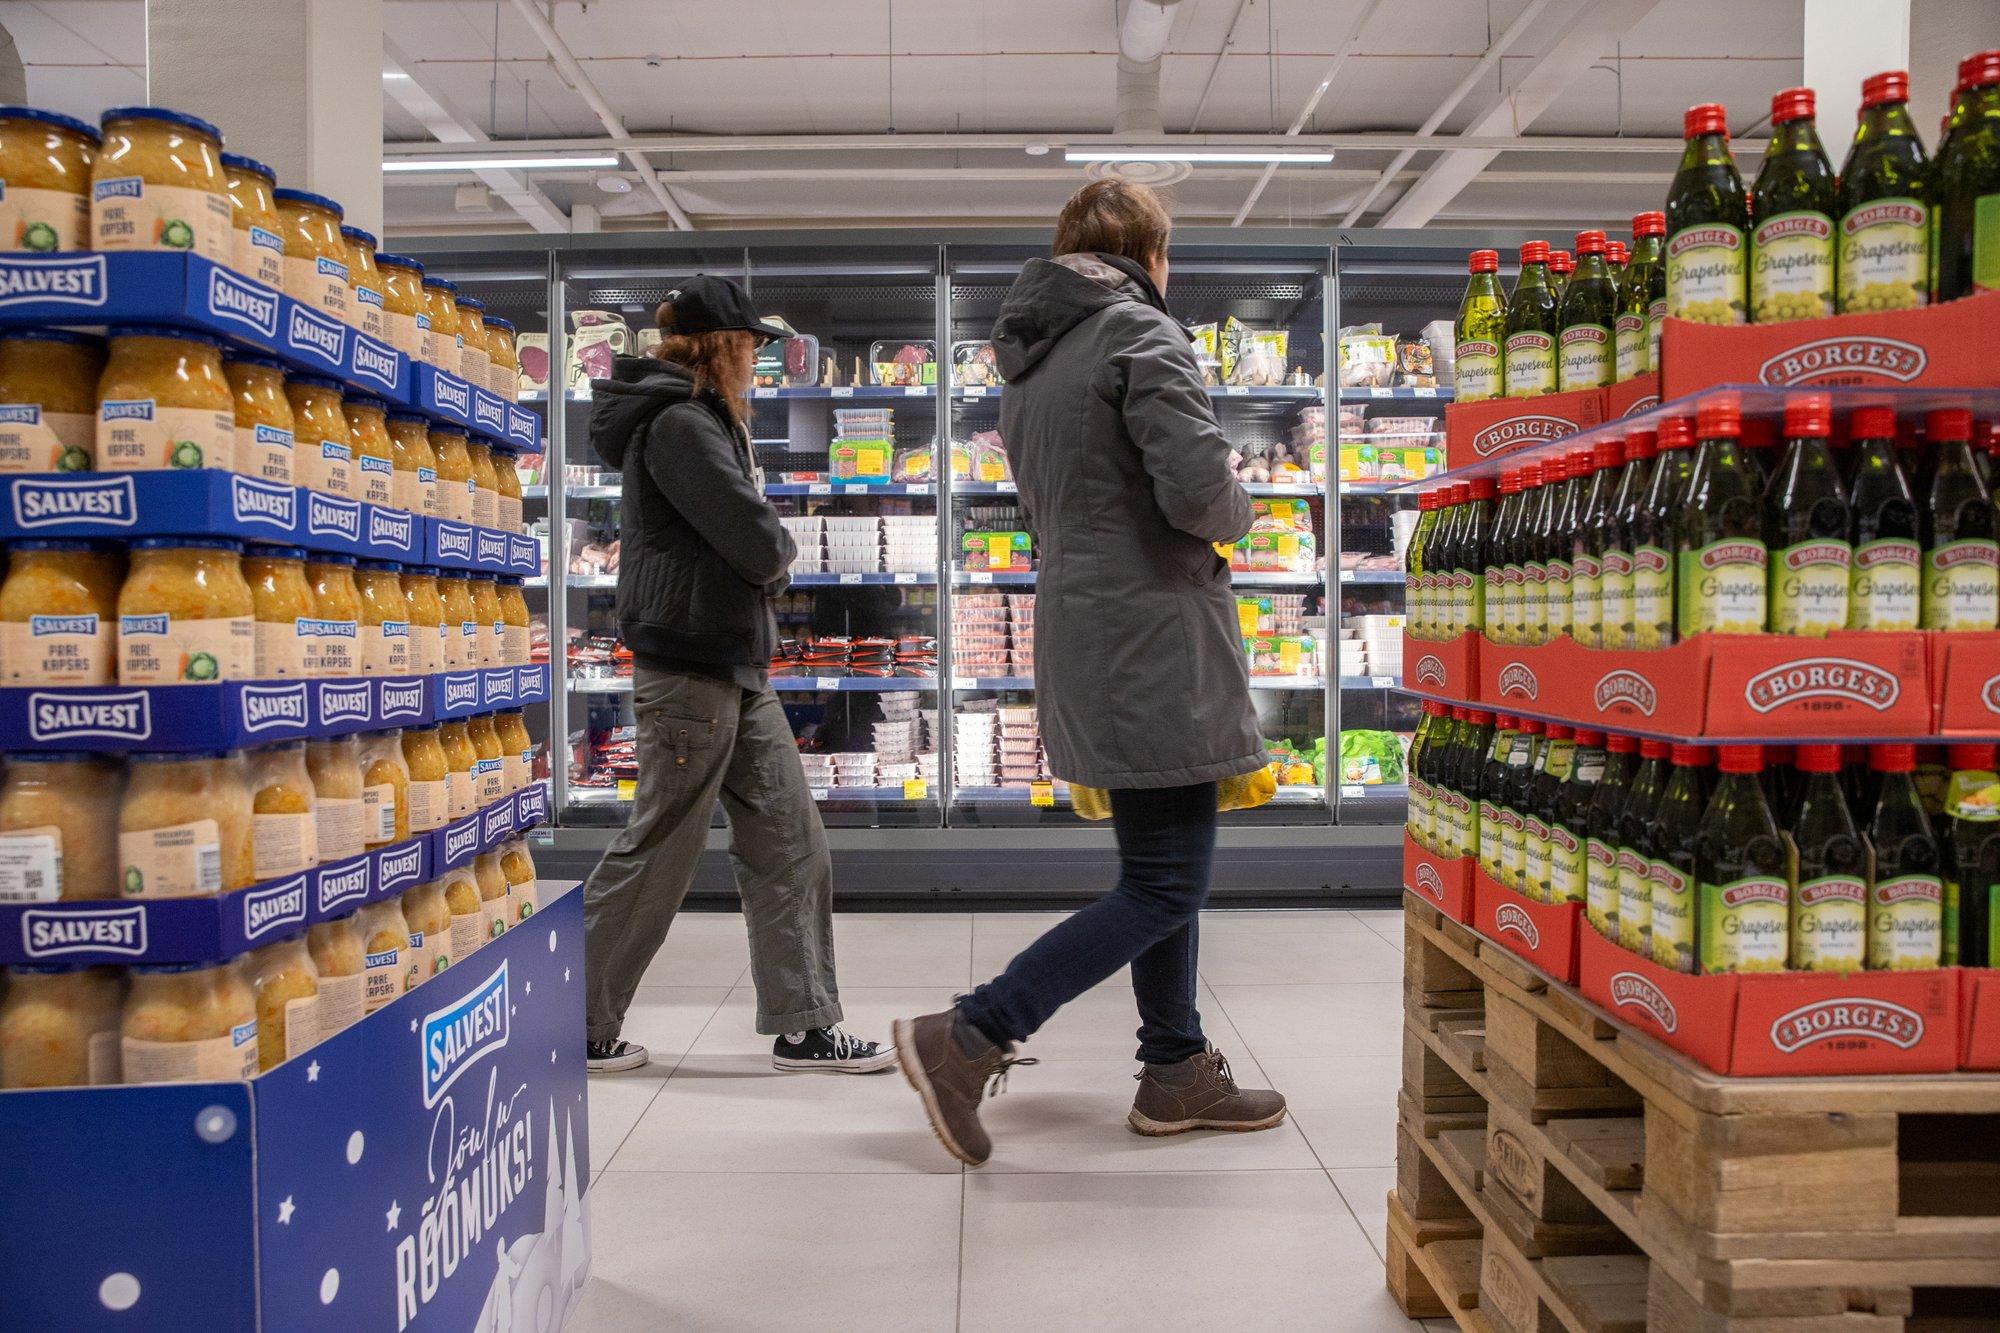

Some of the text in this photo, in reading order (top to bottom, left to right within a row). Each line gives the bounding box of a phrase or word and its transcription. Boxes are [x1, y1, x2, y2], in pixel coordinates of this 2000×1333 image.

[1763, 218, 1823, 238] BORGES
[1852, 204, 1917, 227] BORGES
[1676, 231, 1732, 246] BORGES
[0, 268, 97, 295] SALVEST
[214, 281, 274, 326] SALVEST
[293, 316, 341, 361] SALVEST
[1456, 342, 1493, 357] BORGES
[1507, 335, 1545, 352] BORGES
[1561, 328, 1601, 344] BORGES
[356, 348, 396, 385] SALVEST
[1783, 344, 1898, 377] BORGES
[437, 381, 467, 413] SALVEST
[102, 402, 152, 421] SALVEST
[477, 399, 502, 429] SALVEST
[510, 414, 533, 441] SALVEST
[1487, 421, 1565, 445] BORGES
[24, 489, 125, 517] SALVEST
[238, 486, 291, 525] SALVEST
[313, 507, 357, 538] SALVEST
[372, 520, 409, 547] SALVEST
[440, 533, 470, 558] SALVEST
[480, 538, 504, 562] SALVEST
[513, 544, 533, 566] SALVEST
[33, 618, 95, 635] SALVEST
[315, 620, 355, 636] SALVEST
[486, 677, 511, 699] SALVEST
[520, 673, 542, 693] SALVEST
[1502, 668, 1534, 691] BORGES
[1603, 675, 1648, 698] BORGES
[1769, 666, 1878, 698] BORGES
[324, 694, 367, 719] SALVEST
[384, 690, 420, 714] SALVEST
[448, 682, 476, 705] SALVEST
[39, 703, 140, 730] SALVEST
[249, 694, 303, 723] SALVEST
[521, 794, 543, 817] SAVEST
[448, 827, 476, 857] SALVEST
[382, 852, 418, 883] SALVEST
[322, 869, 366, 903] SALVEST
[249, 888, 302, 929] SALVEST
[33, 918, 137, 947] SALVEST
[1500, 907, 1536, 938] BORGES
[1619, 979, 1668, 1019] BORGES
[429, 983, 503, 1083] SALVEST
[1795, 1006, 1902, 1034] BORGES
